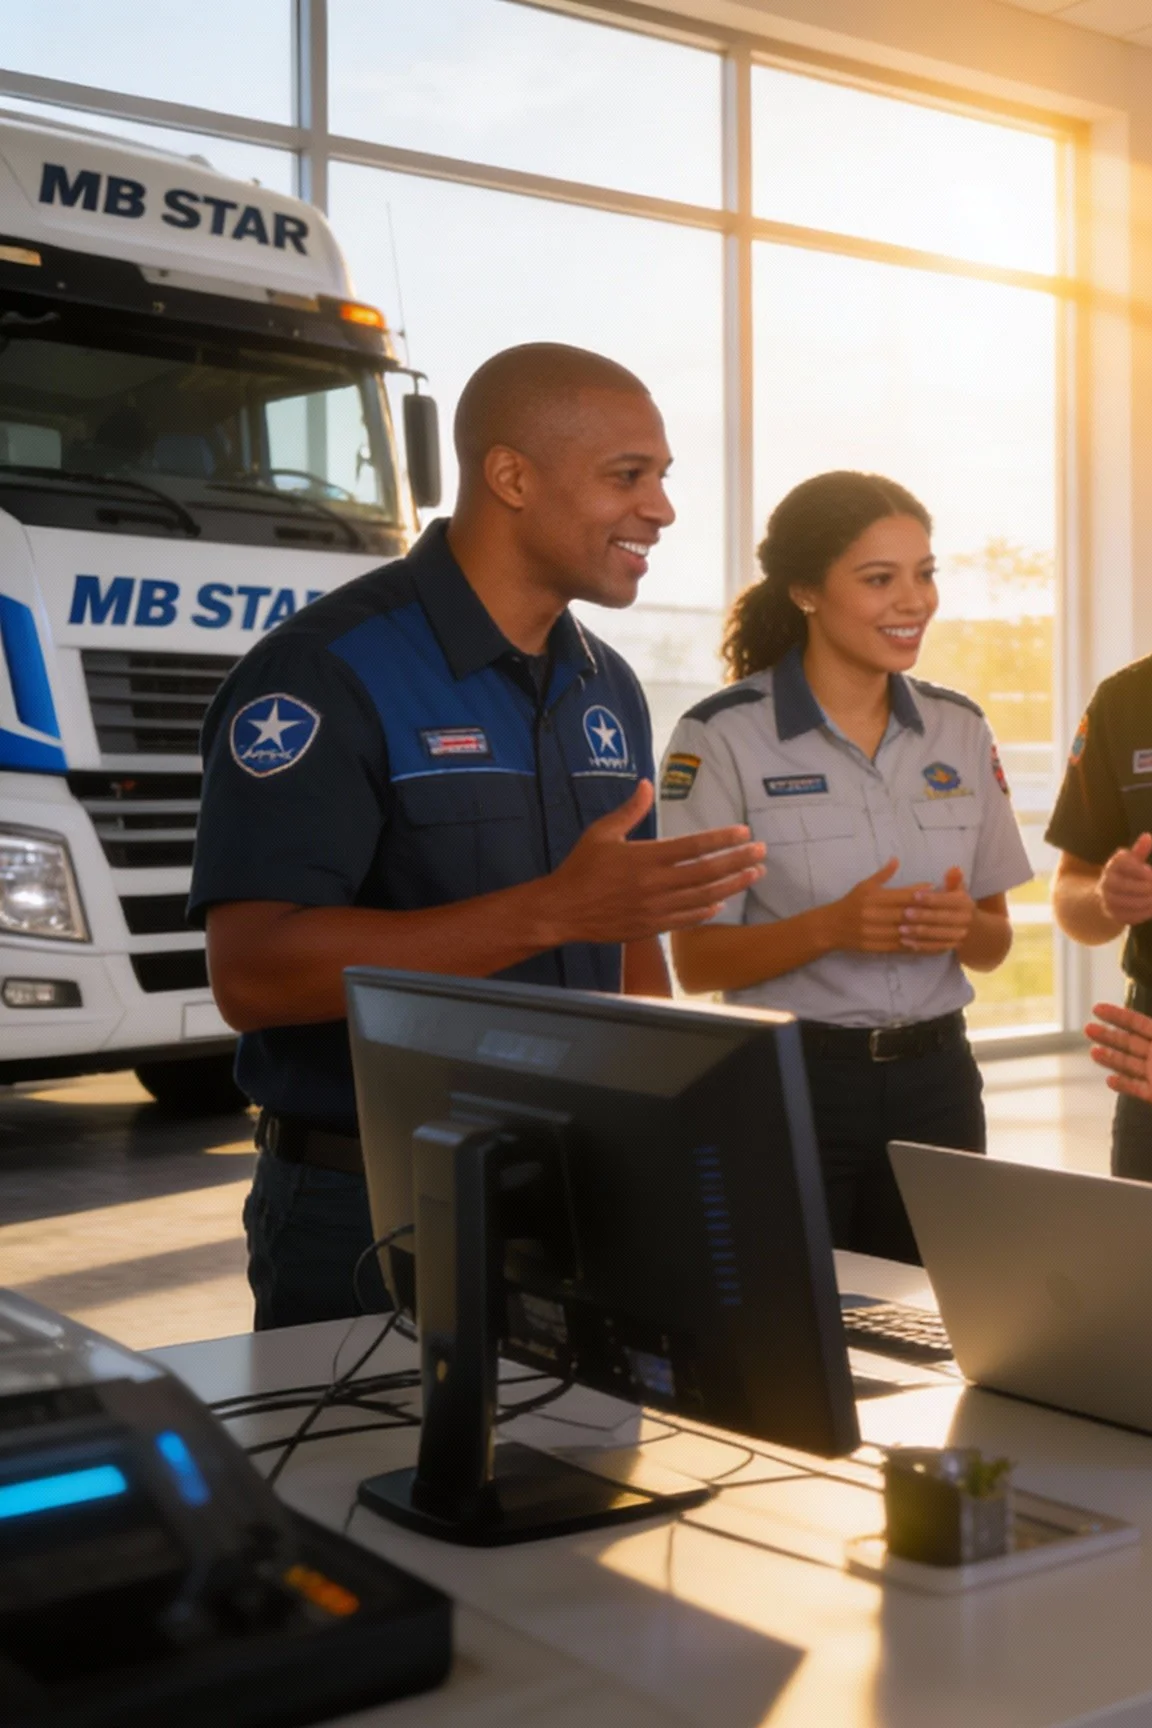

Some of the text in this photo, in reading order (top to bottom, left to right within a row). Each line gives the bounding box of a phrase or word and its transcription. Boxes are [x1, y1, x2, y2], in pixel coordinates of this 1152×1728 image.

[39, 163, 310, 257] MB STAR
[68, 575, 325, 631] MB STA
